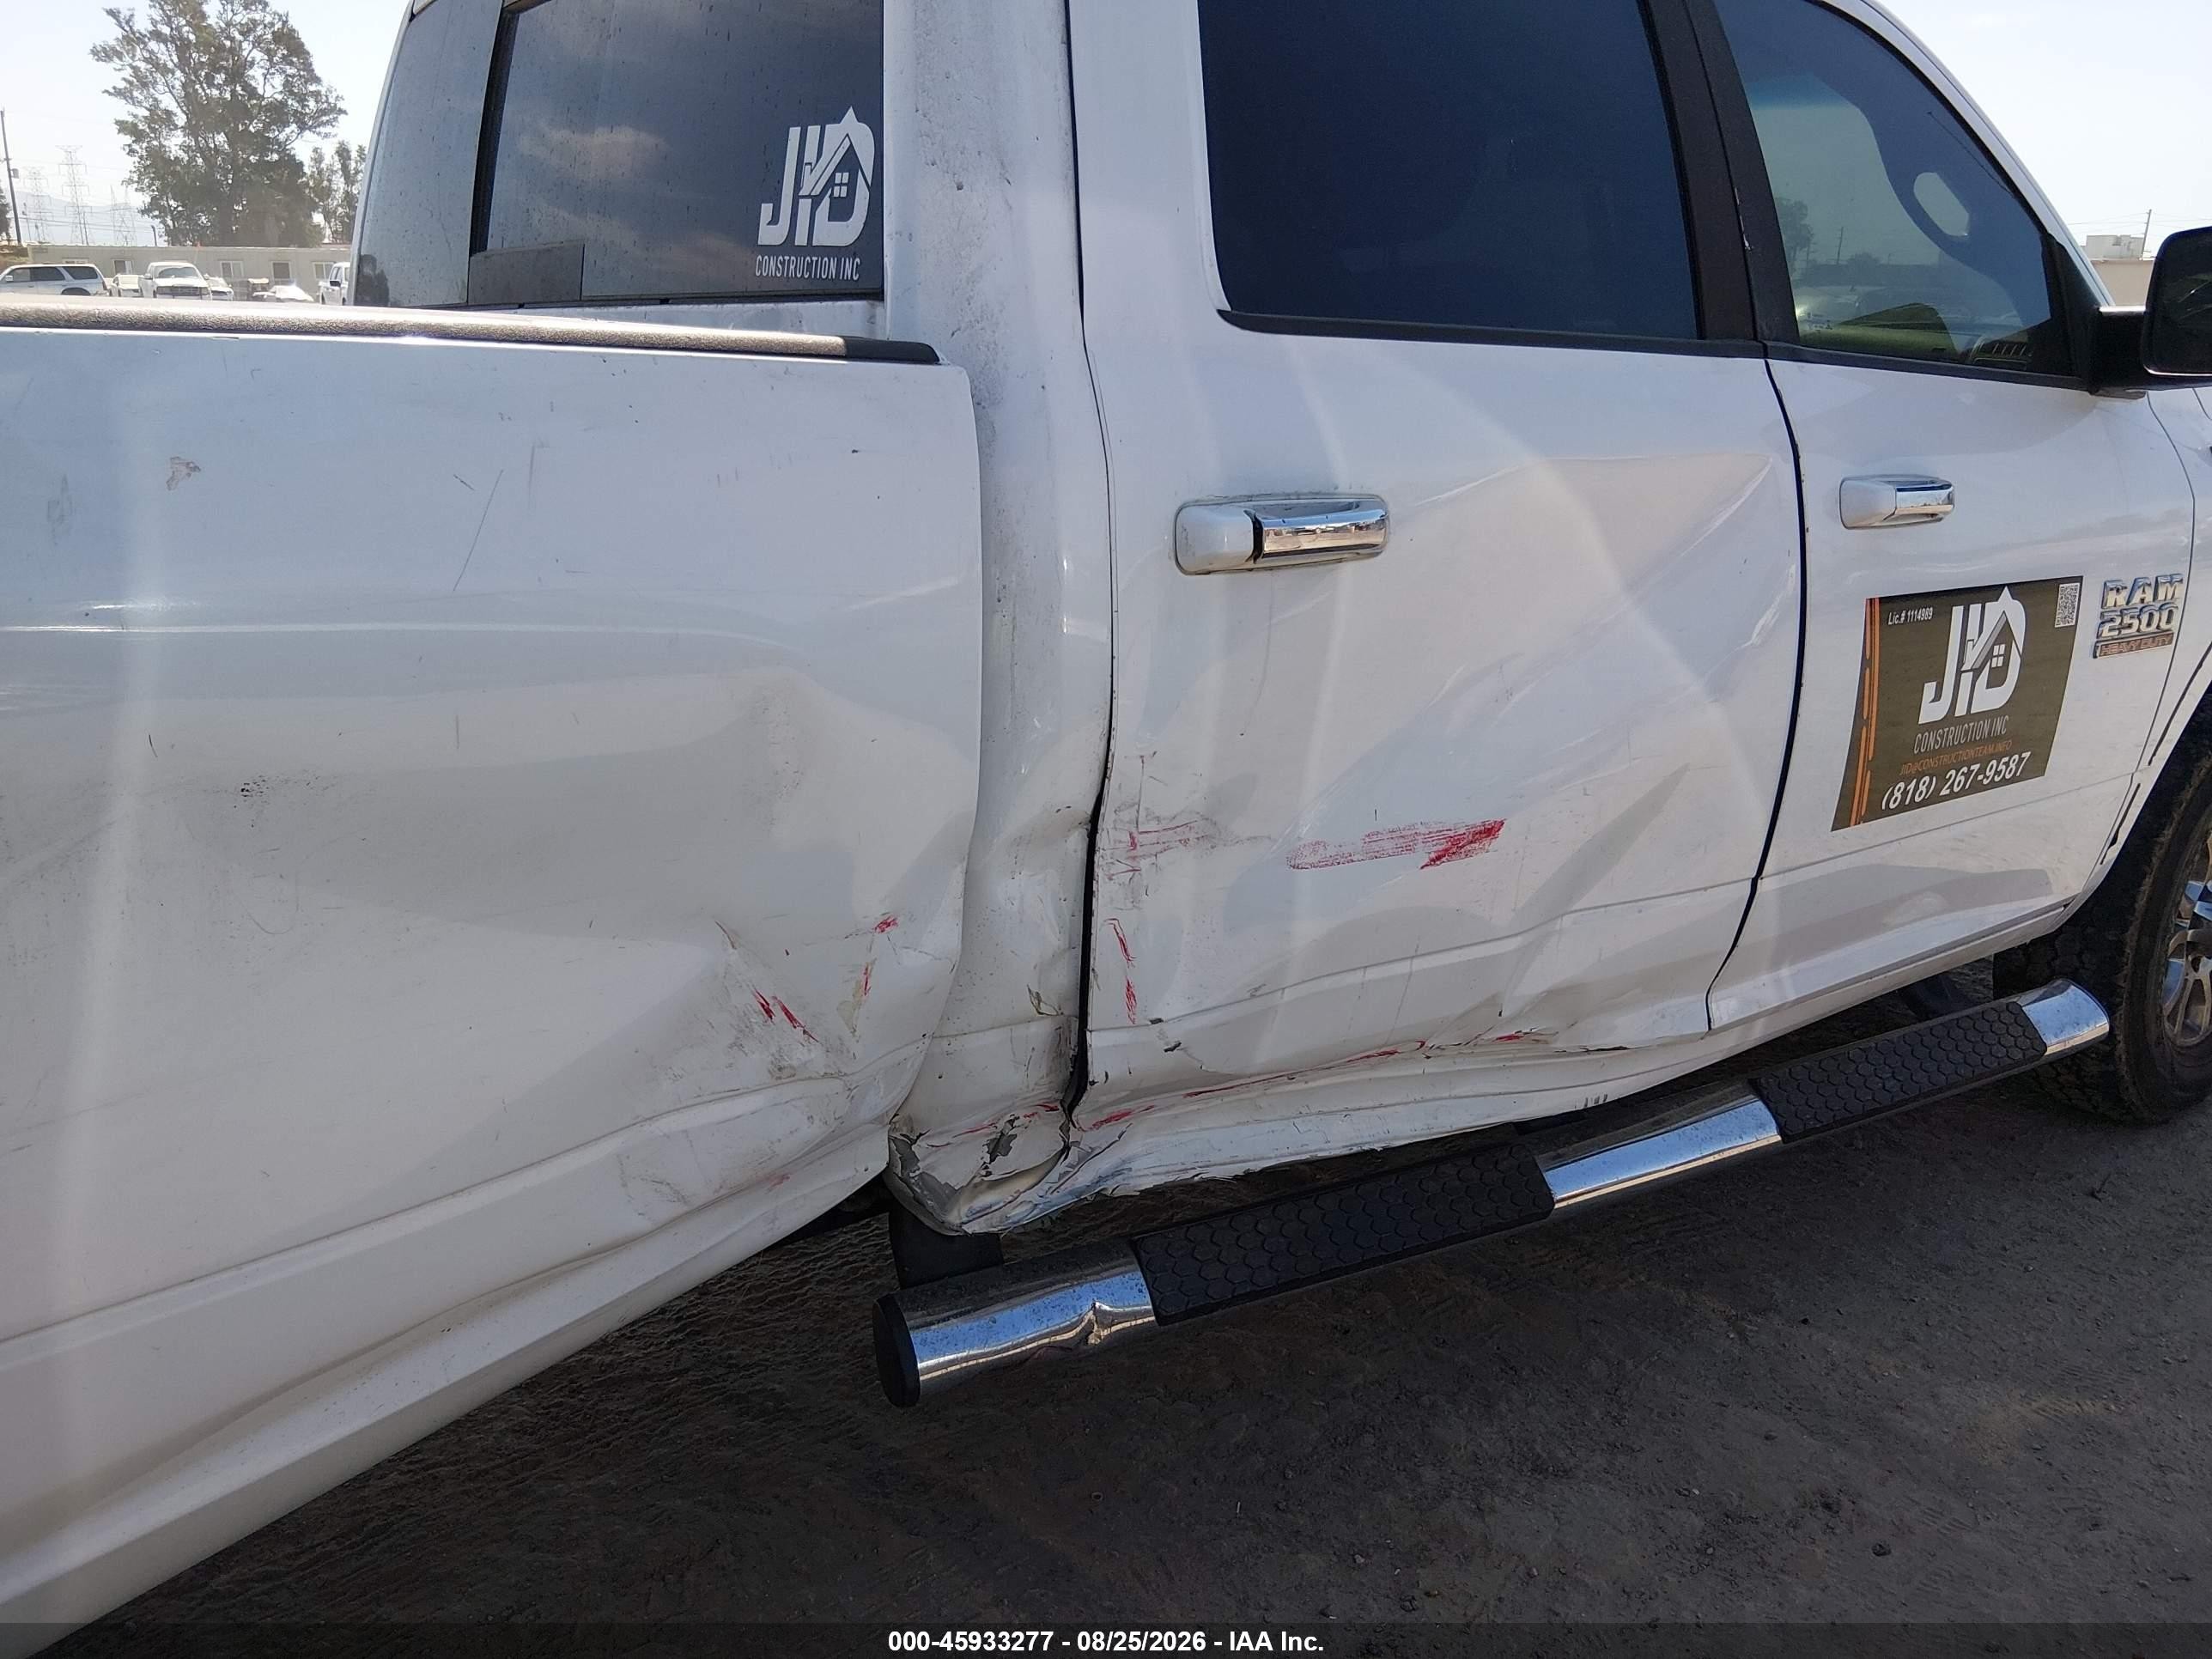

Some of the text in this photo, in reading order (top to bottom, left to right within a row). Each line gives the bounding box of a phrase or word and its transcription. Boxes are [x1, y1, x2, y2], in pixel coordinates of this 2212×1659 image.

[755, 255, 860, 281] CONSTRUCTION INC
[2101, 574, 2183, 610] RAM
[1887, 610, 1906, 625] Lic.#
[2096, 602, 2179, 639] 2500
[2100, 634, 2172, 656] HEAVY DUTY
[1913, 714, 2009, 755] CONSTRUCTION INC
[1881, 750, 2032, 811] (818) 267-9587
